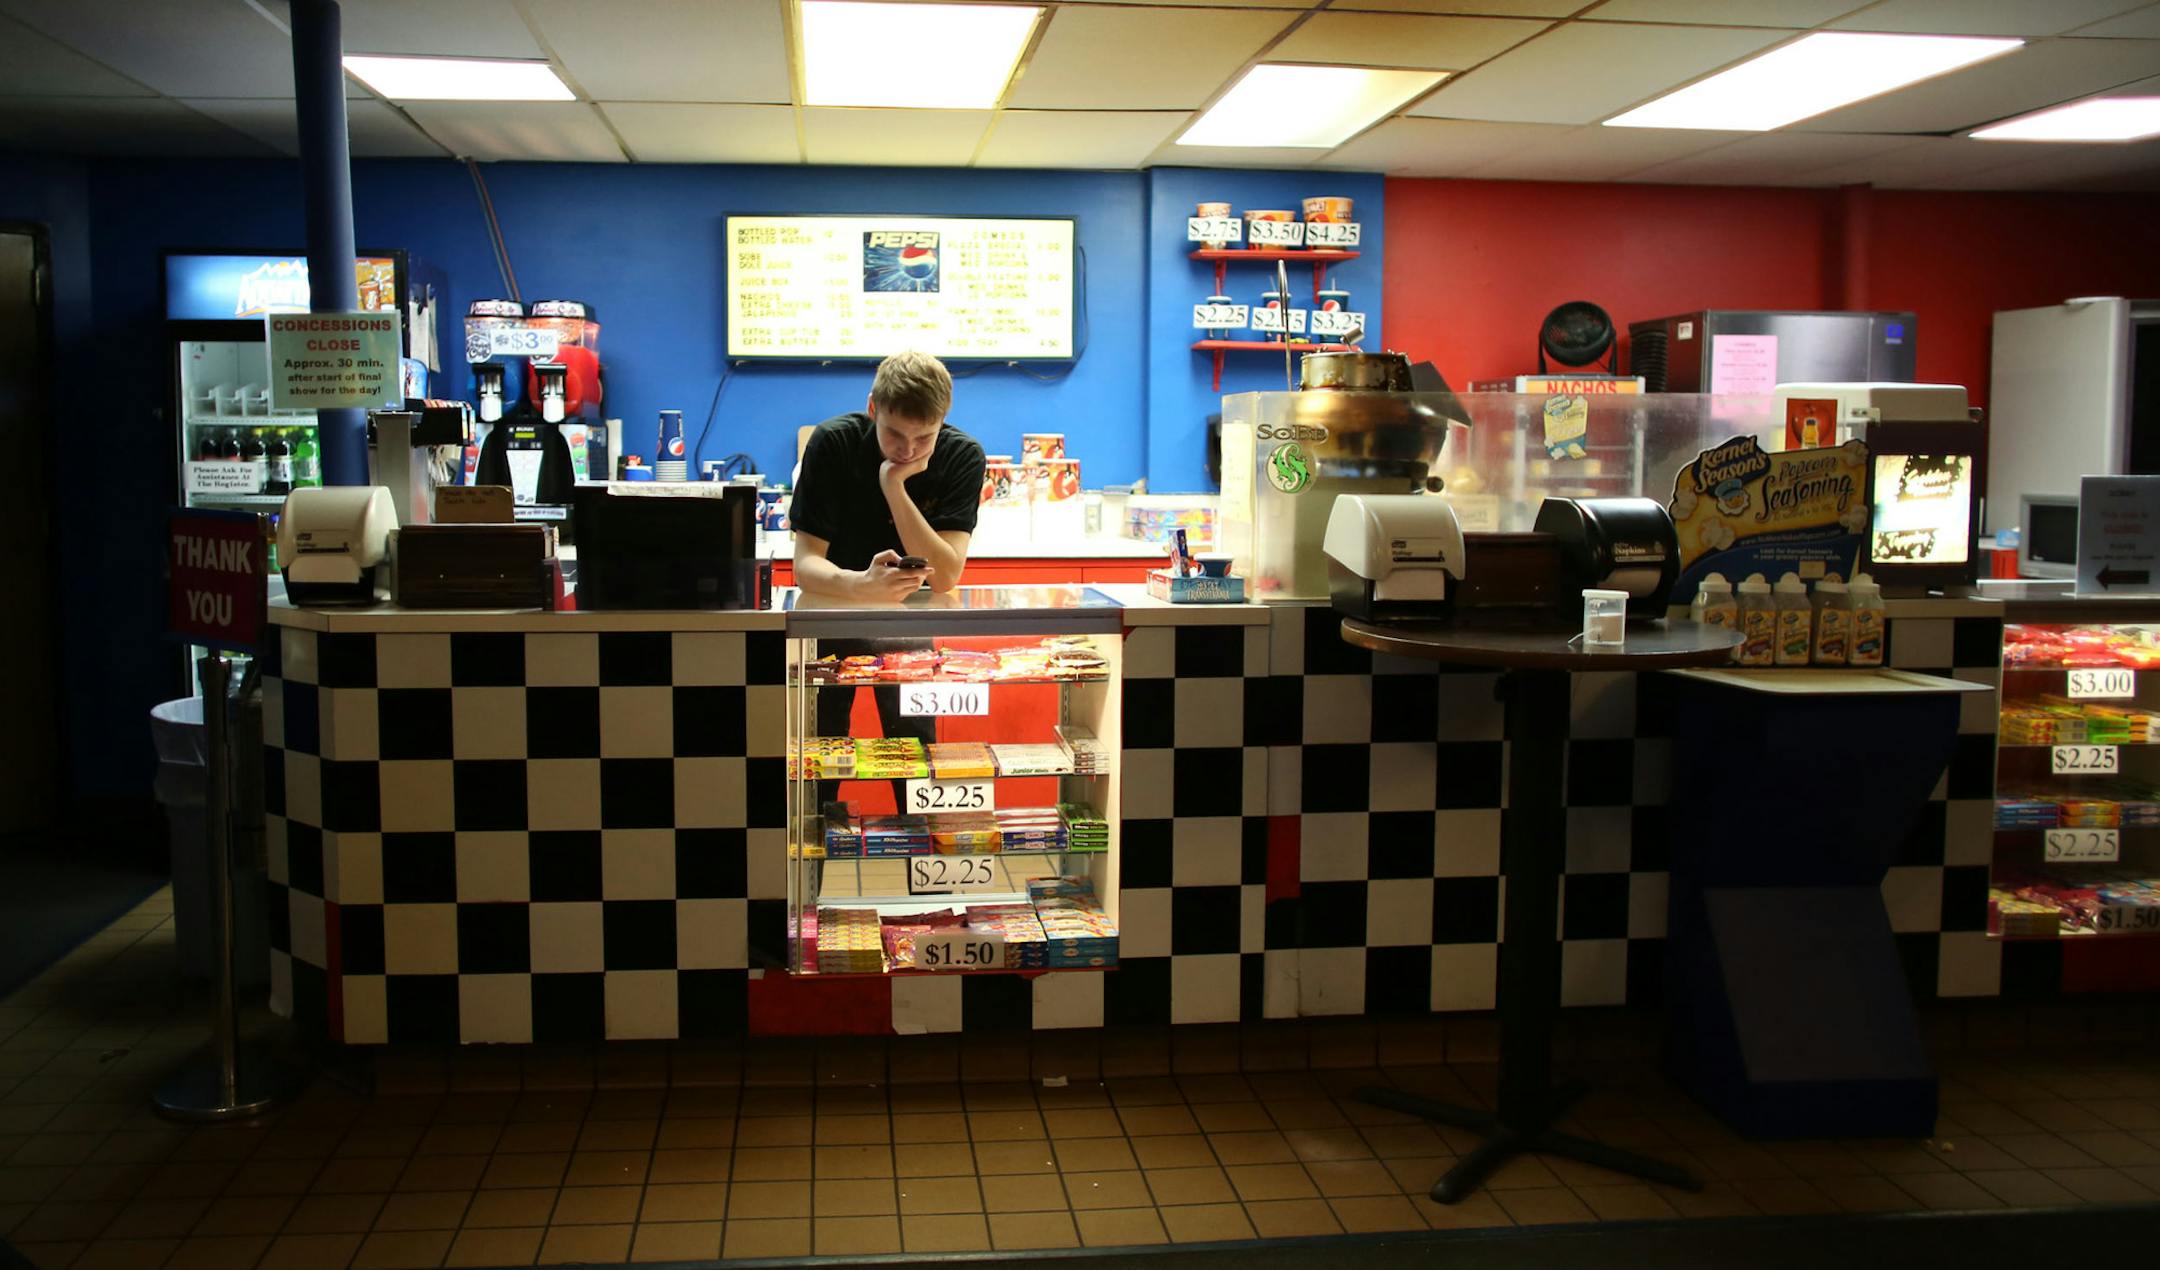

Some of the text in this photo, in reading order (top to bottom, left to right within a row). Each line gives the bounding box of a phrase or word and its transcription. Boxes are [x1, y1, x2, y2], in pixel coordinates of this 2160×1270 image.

[738, 228, 776, 236] BOTTLED
[1190, 220, 1239, 239] $2.75
[1250, 222, 1302, 242] $3.50
[1308, 225, 1358, 243] $4.25
[738, 236, 776, 244] BOTTLED
[869, 232, 938, 248] PEPSI
[1196, 307, 1246, 323] $2.25
[1314, 312, 1362, 331] $3.25
[273, 319, 391, 332] CONCESSIONS
[306, 339, 361, 351] CLOSE
[284, 358, 384, 370] Approx. 30 min.
[288, 372, 382, 382] after start of final
[289, 385, 382, 397] show for the day!
[1547, 380, 1618, 395] NACHOS
[1701, 436, 1757, 470] Kernel
[1695, 452, 1767, 493] Season's
[1779, 456, 1837, 481] Popcorn
[1754, 474, 1855, 522] Seasoning
[173, 536, 253, 574] THANK
[1614, 546, 1646, 556] Napkins
[186, 590, 232, 626] YOU
[2071, 672, 2131, 695] $3.00
[909, 691, 979, 715] $3.00
[2054, 748, 2116, 771] $2.25
[916, 783, 985, 808] $2.25
[2047, 832, 2117, 860] $2.25
[914, 858, 993, 888] $2.25
[2099, 907, 2159, 930] $1.50
[925, 942, 994, 966] $1.50
